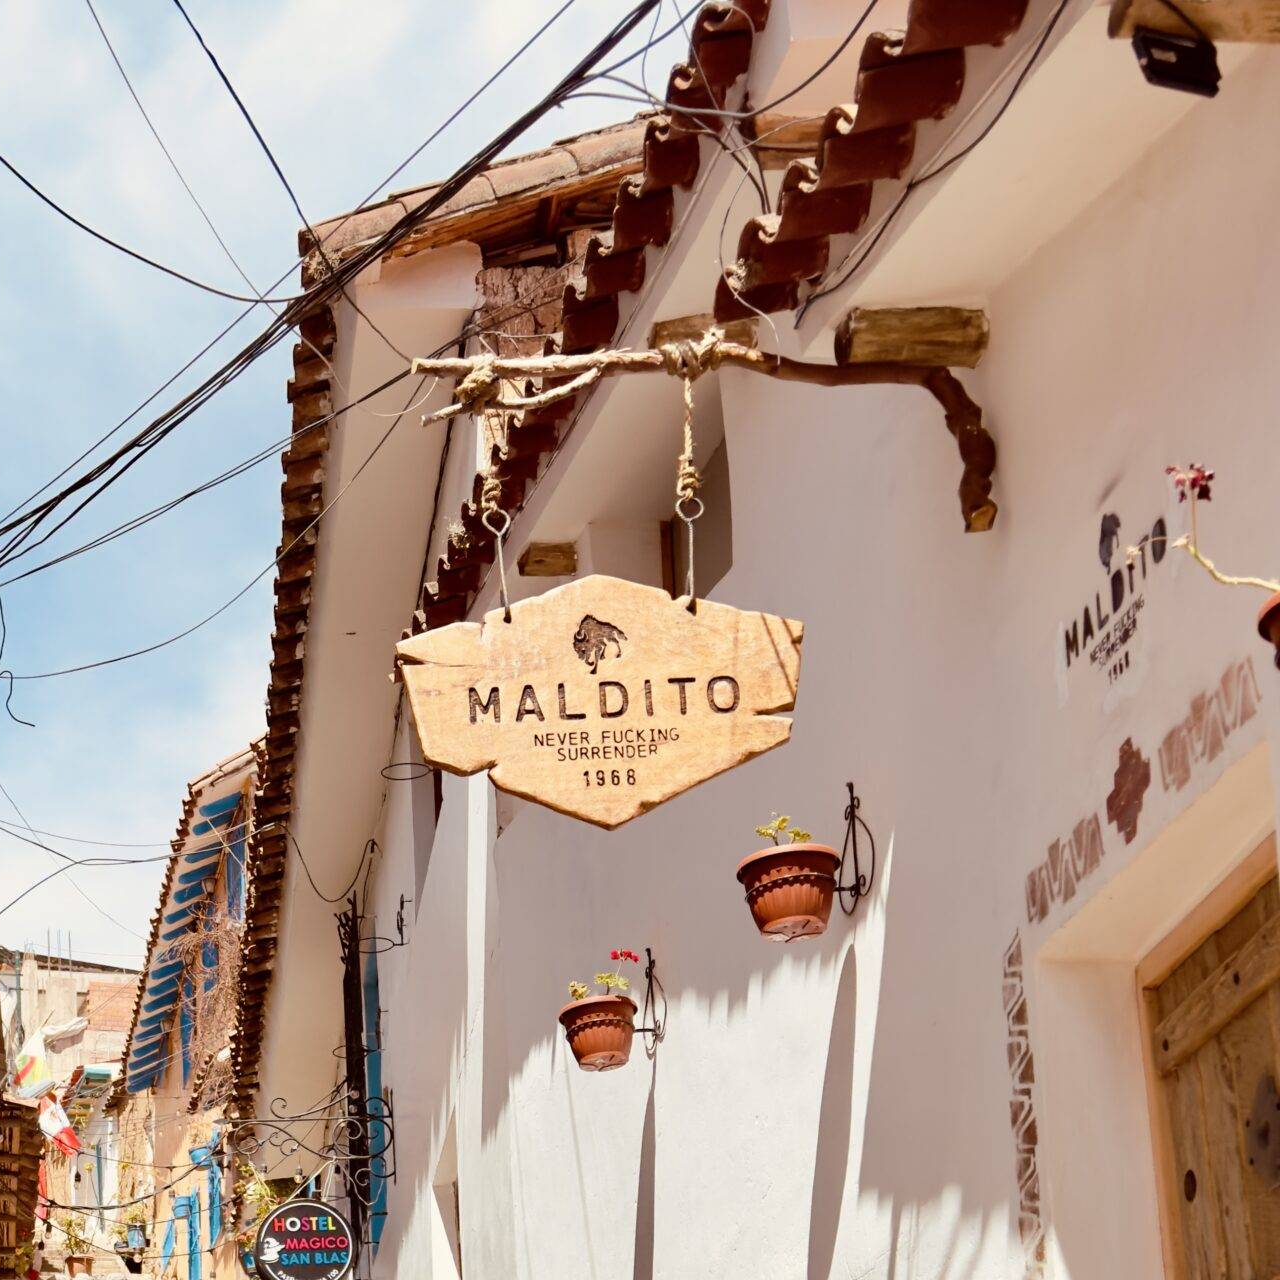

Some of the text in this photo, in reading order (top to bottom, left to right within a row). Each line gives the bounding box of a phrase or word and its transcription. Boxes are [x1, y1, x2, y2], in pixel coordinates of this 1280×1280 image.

[1065, 517, 1167, 668] MALDITO
[467, 675, 741, 725] MALDITO
[534, 727, 680, 747] NEVER FUCKING
[557, 744, 659, 762] SURRENDER
[583, 768, 637, 787] 1968
[273, 1216, 337, 1232] HOSTEL
[284, 1236, 349, 1250] MAGICO
[280, 1251, 349, 1266] SAN BLAS
